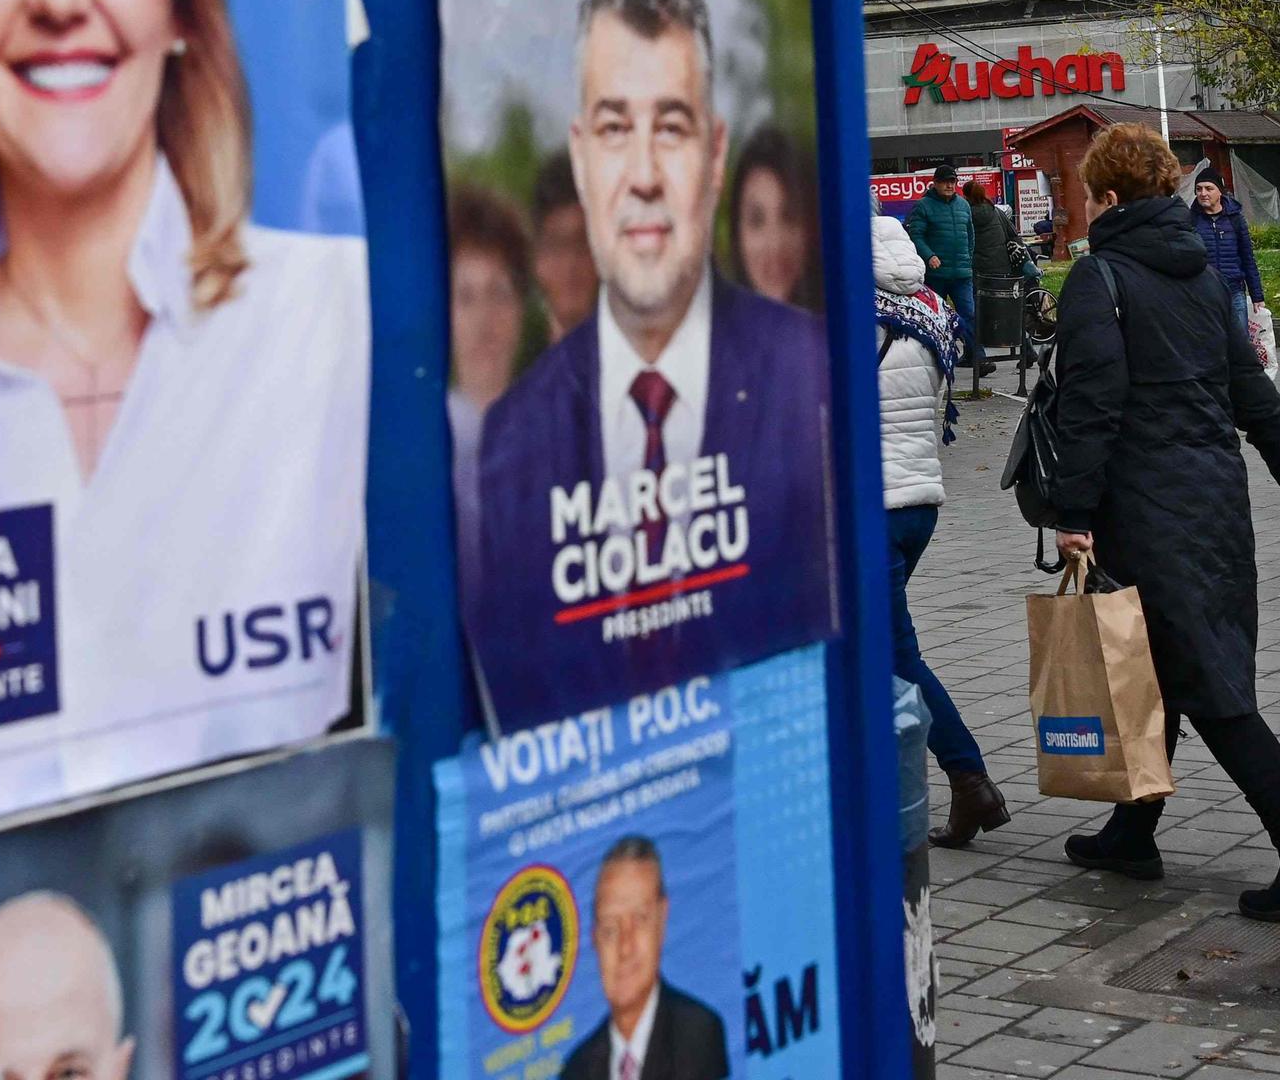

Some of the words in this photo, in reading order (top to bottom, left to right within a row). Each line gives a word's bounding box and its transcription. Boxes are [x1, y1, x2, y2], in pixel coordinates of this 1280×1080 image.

[902, 43, 1126, 105] Auchan
[550, 451, 746, 544] MARCEL
[552, 506, 750, 603] CIOLACU
[196, 596, 340, 677] USR
[602, 590, 714, 643] PREȘEDINTE
[480, 706, 615, 793] VOTAȚI
[628, 675, 720, 745] P.O.C.
[1045, 731, 1099, 748] SPORTISIMO
[200, 850, 339, 930] MIRCEA
[183, 879, 356, 989] GEOANĂ
[182, 943, 358, 1065] 2024
